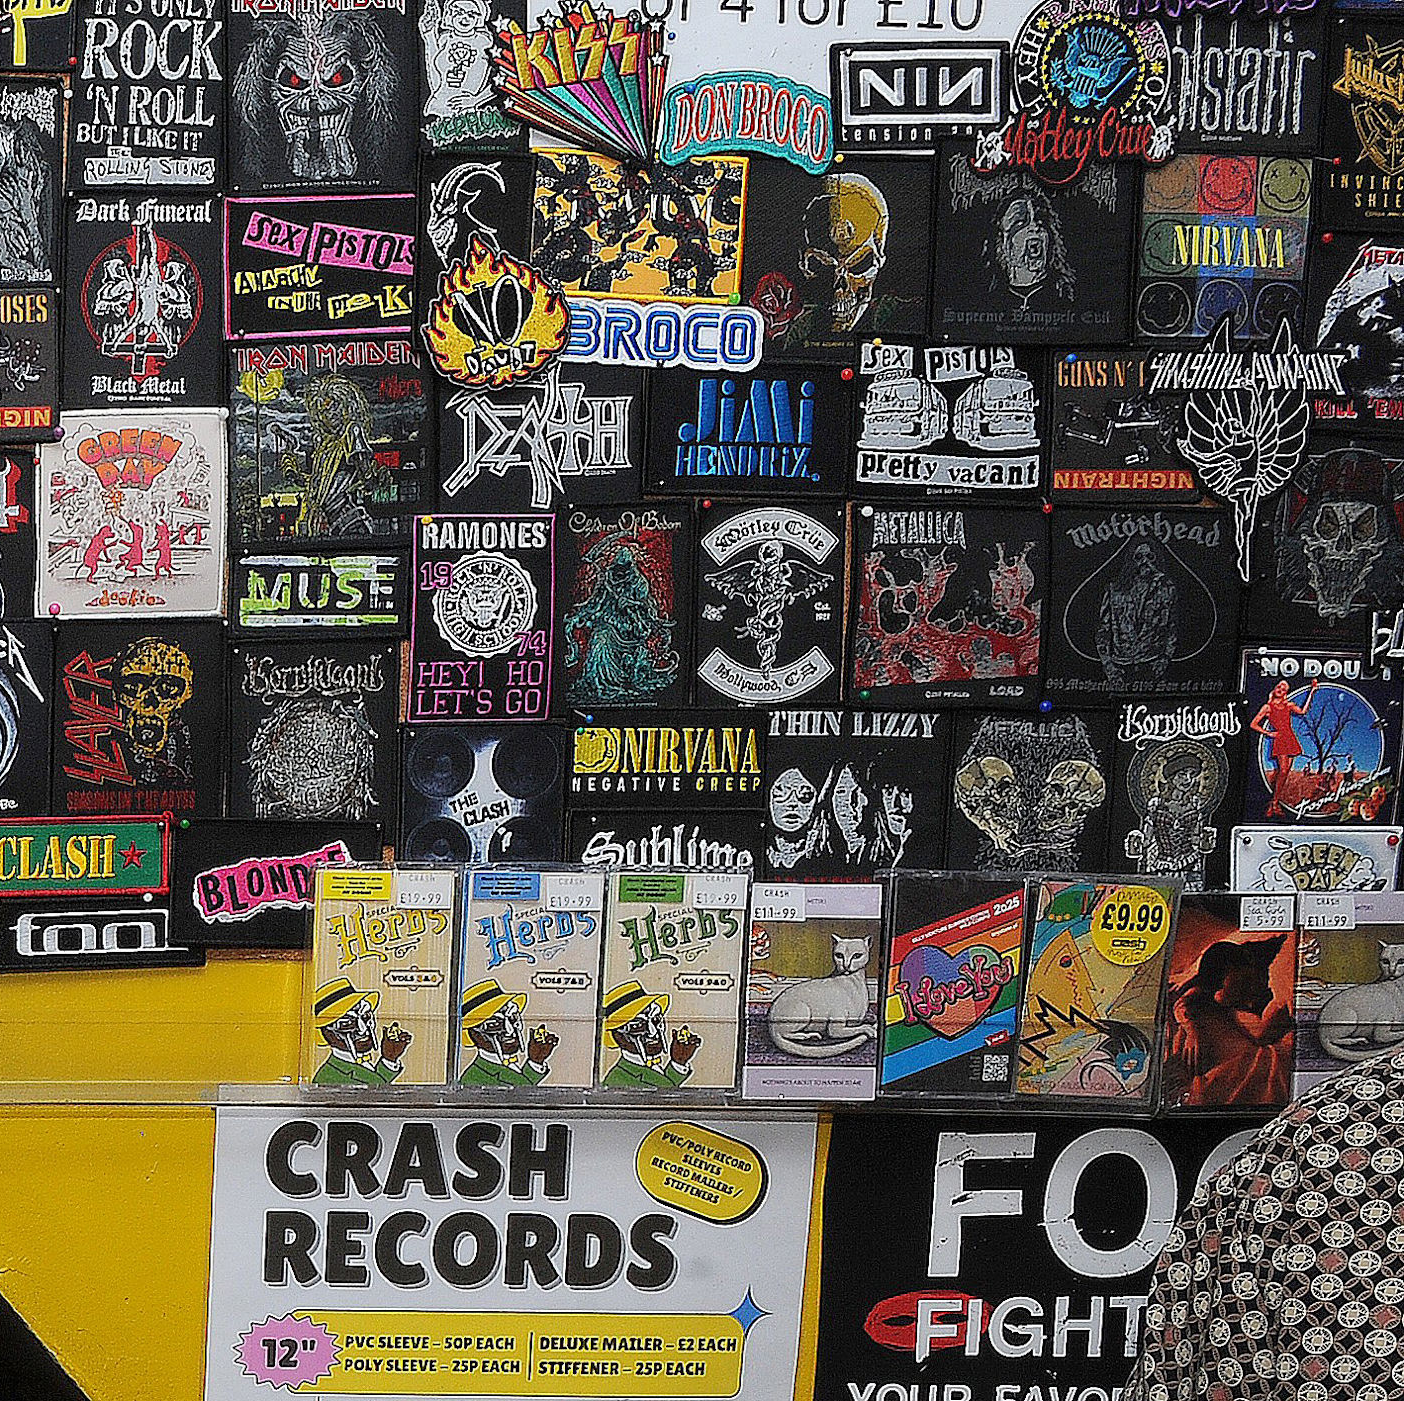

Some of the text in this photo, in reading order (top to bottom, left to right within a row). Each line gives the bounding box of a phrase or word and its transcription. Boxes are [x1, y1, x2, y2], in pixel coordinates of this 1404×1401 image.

[80, 18, 223, 81] ROCK
[511, 22, 640, 91] KISS
[128, 84, 215, 127] ROLL
[76, 123, 202, 151] BUT LIKE IT
[672, 82, 829, 163] DON BROCO
[76, 198, 212, 226] Dark Funeral
[1171, 223, 1285, 269] NIRVANA
[451, 275, 523, 352] NO
[568, 303, 756, 365] BROCO
[91, 376, 187, 396] Black Metal
[1057, 360, 1106, 387] GUNS
[78, 428, 184, 465] GREEN
[94, 458, 168, 492] DAY
[861, 455, 938, 481] pretty
[421, 521, 548, 551] RAMONES
[872, 511, 967, 549] METALLICA
[1065, 511, 1222, 549] Motörhead
[420, 561, 454, 591] 19
[514, 630, 547, 657] 74
[417, 660, 545, 688] HEY! HO
[1261, 658, 1299, 678] NO
[64, 649, 139, 787] SLAYER
[416, 689, 543, 715] LET'S GO
[768, 710, 940, 739] THIN LIZZY
[622, 727, 762, 774] NIRVANA
[571, 776, 762, 793] NEGATIVE CREEP
[449, 794, 512, 828] THE CLASH
[580, 823, 754, 870] Sublime
[1279, 843, 1361, 875] GREEN
[993, 896, 1020, 918] 2025
[1100, 901, 1164, 934] £9.99
[619, 904, 740, 973] Herbs
[265, 1121, 572, 1201] CRASH
[262, 1210, 679, 1291] RECORDS
[261, 1337, 318, 1369] 12"
[344, 1335, 738, 1354] PVC SLEEVE 50P EACH DELUXE MAILER £2 EACH
[343, 1358, 706, 1377] POLY SLEEVE 25P EACH STIFFENER 25P EACH
